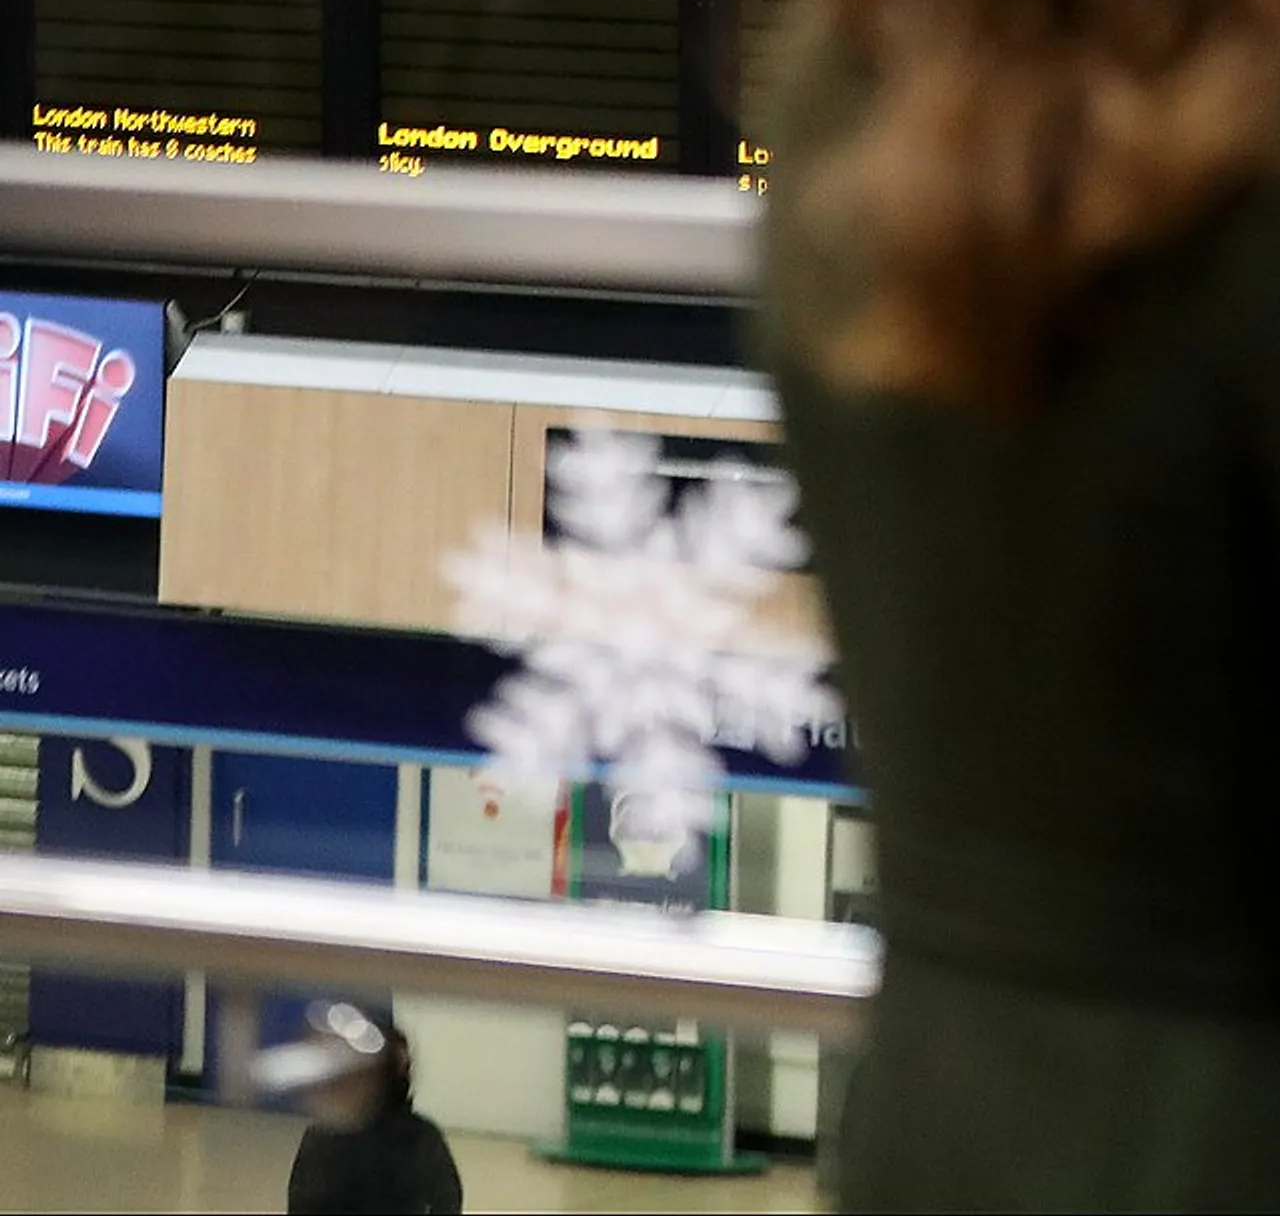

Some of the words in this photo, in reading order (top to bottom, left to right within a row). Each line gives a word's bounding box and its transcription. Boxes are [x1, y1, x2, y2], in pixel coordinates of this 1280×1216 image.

[33, 104, 108, 130] London
[114, 108, 257, 138] Northwestern
[33, 132, 71, 153] This
[77, 134, 122, 157] train
[128, 136, 158, 158] has
[184, 143, 257, 164] coaches
[378, 122, 478, 150] London
[489, 128, 658, 161] Overground
